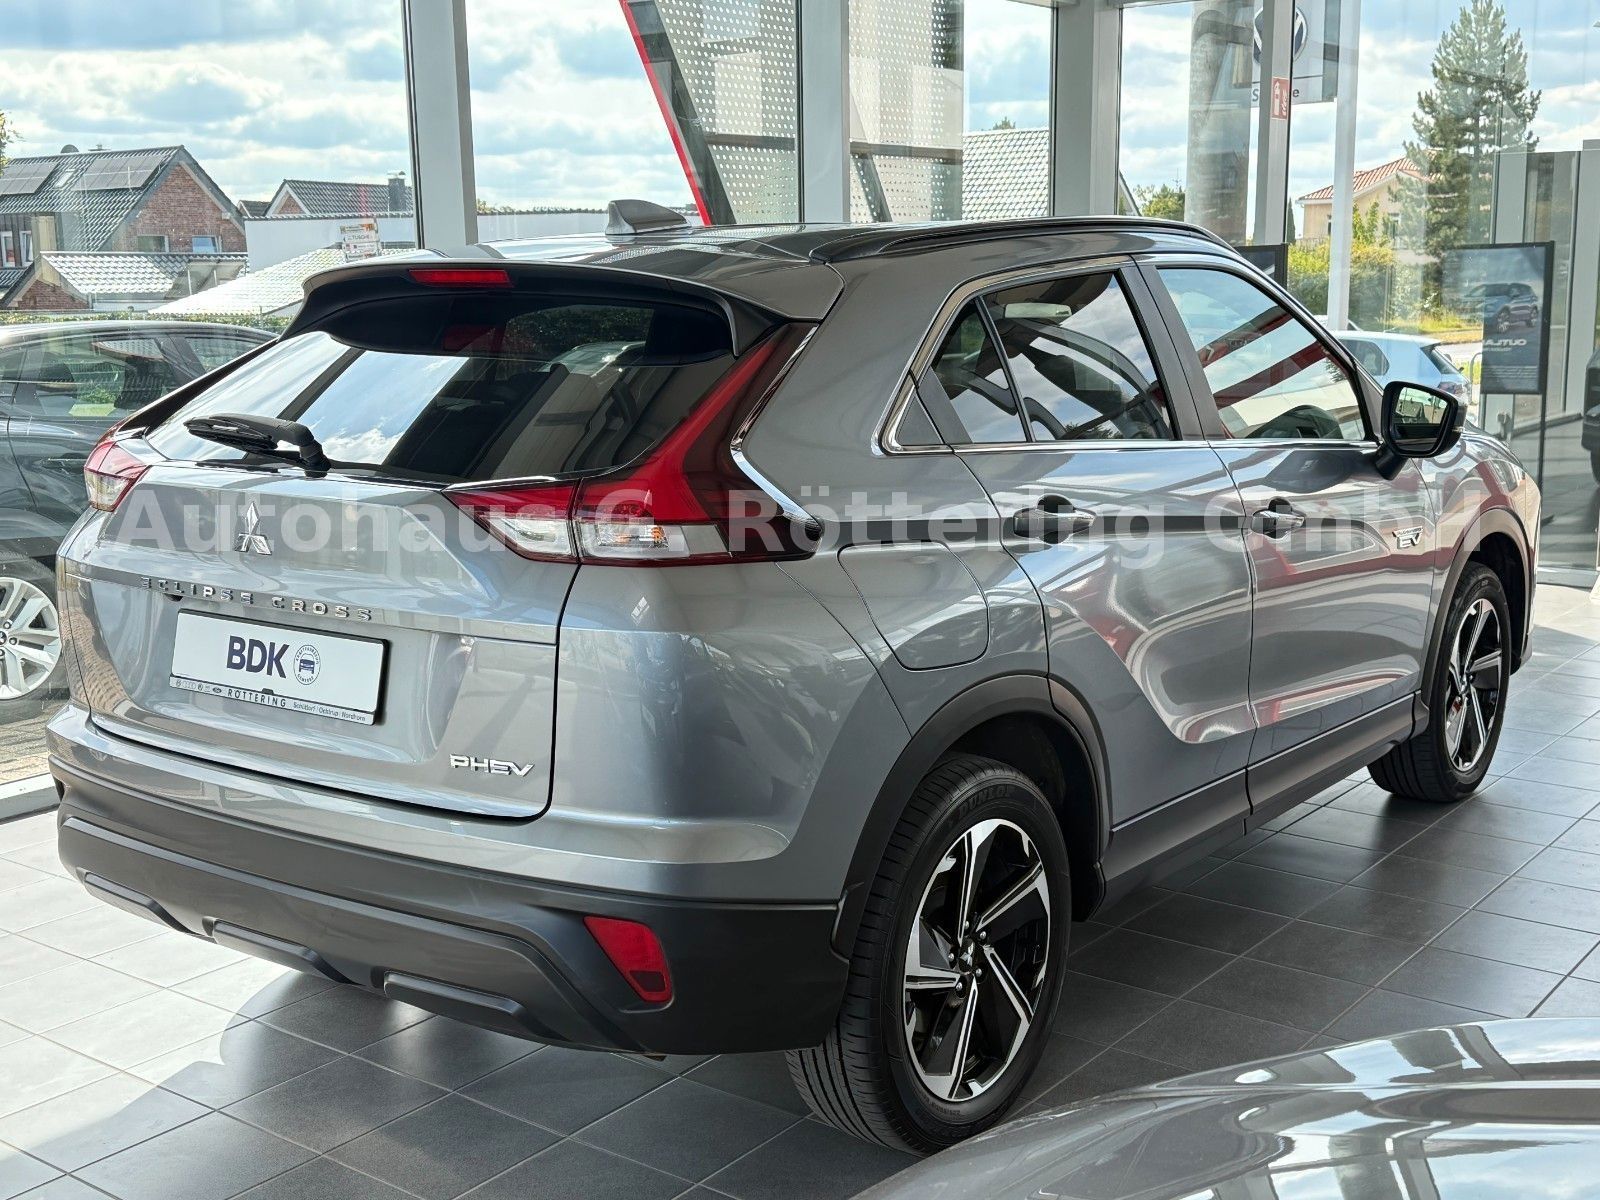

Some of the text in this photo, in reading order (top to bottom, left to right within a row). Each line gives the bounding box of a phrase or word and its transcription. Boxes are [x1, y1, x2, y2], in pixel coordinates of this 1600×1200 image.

[141, 576, 373, 622] ECLIPSE CROSS
[227, 635, 290, 679] BDK
[449, 753, 535, 777] PHEV
